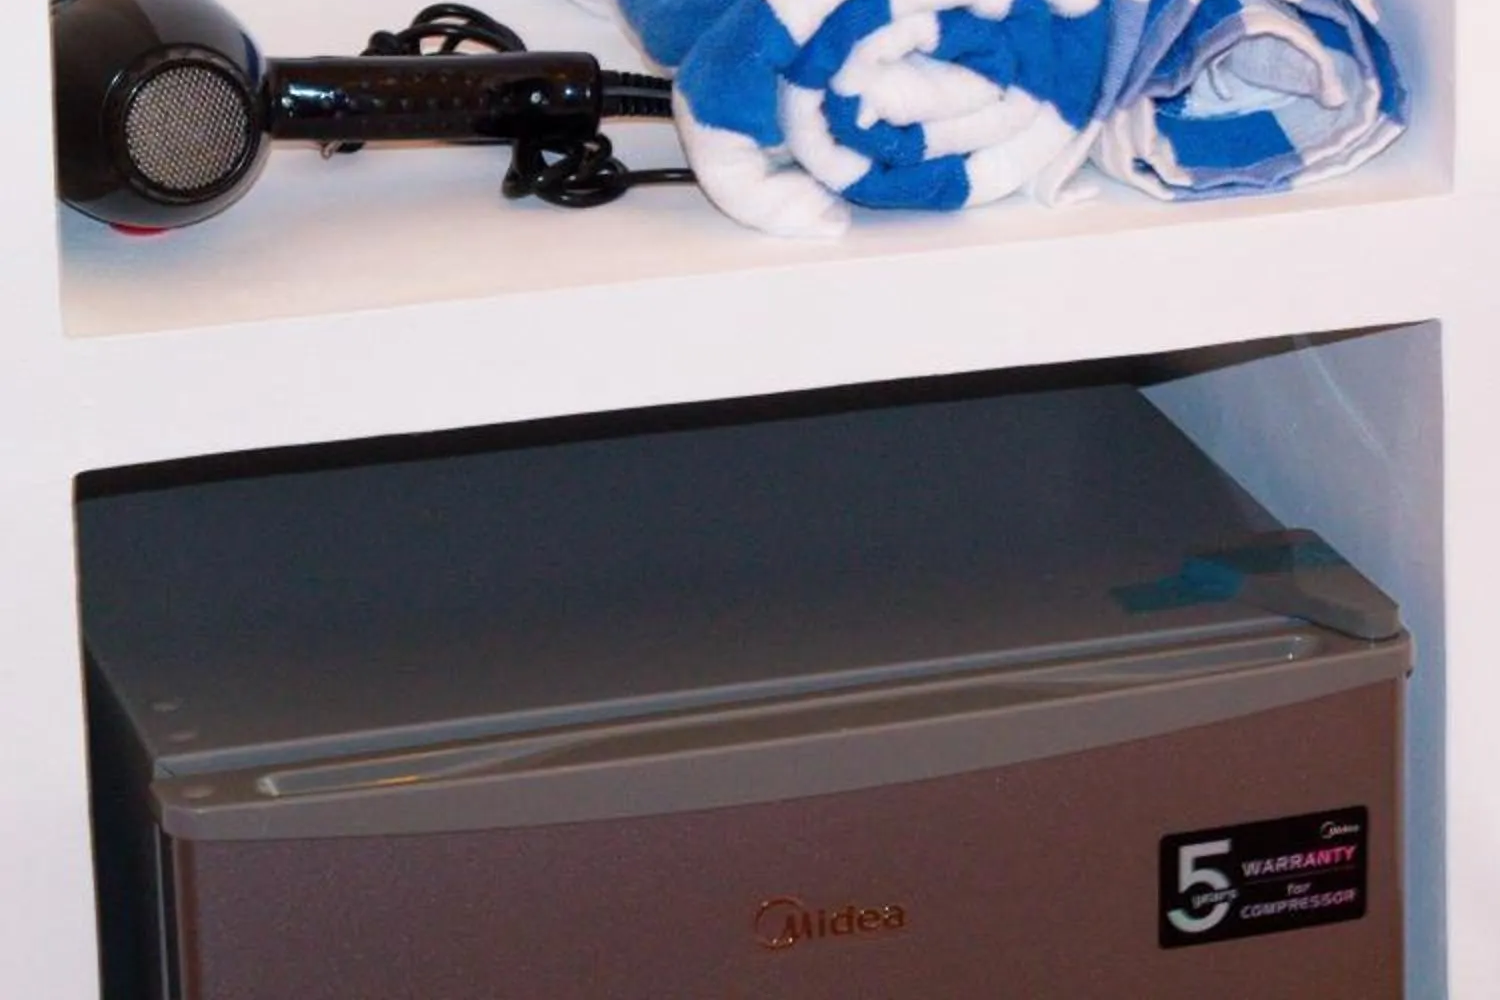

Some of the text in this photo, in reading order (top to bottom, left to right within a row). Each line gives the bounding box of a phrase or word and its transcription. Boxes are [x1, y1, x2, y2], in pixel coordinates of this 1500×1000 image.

[1241, 845, 1356, 876] WARRANTY
[1167, 838, 1231, 933] 5
[1287, 882, 1312, 897] for
[1240, 888, 1356, 919] COMPRESSOR
[755, 898, 905, 950] Midea
